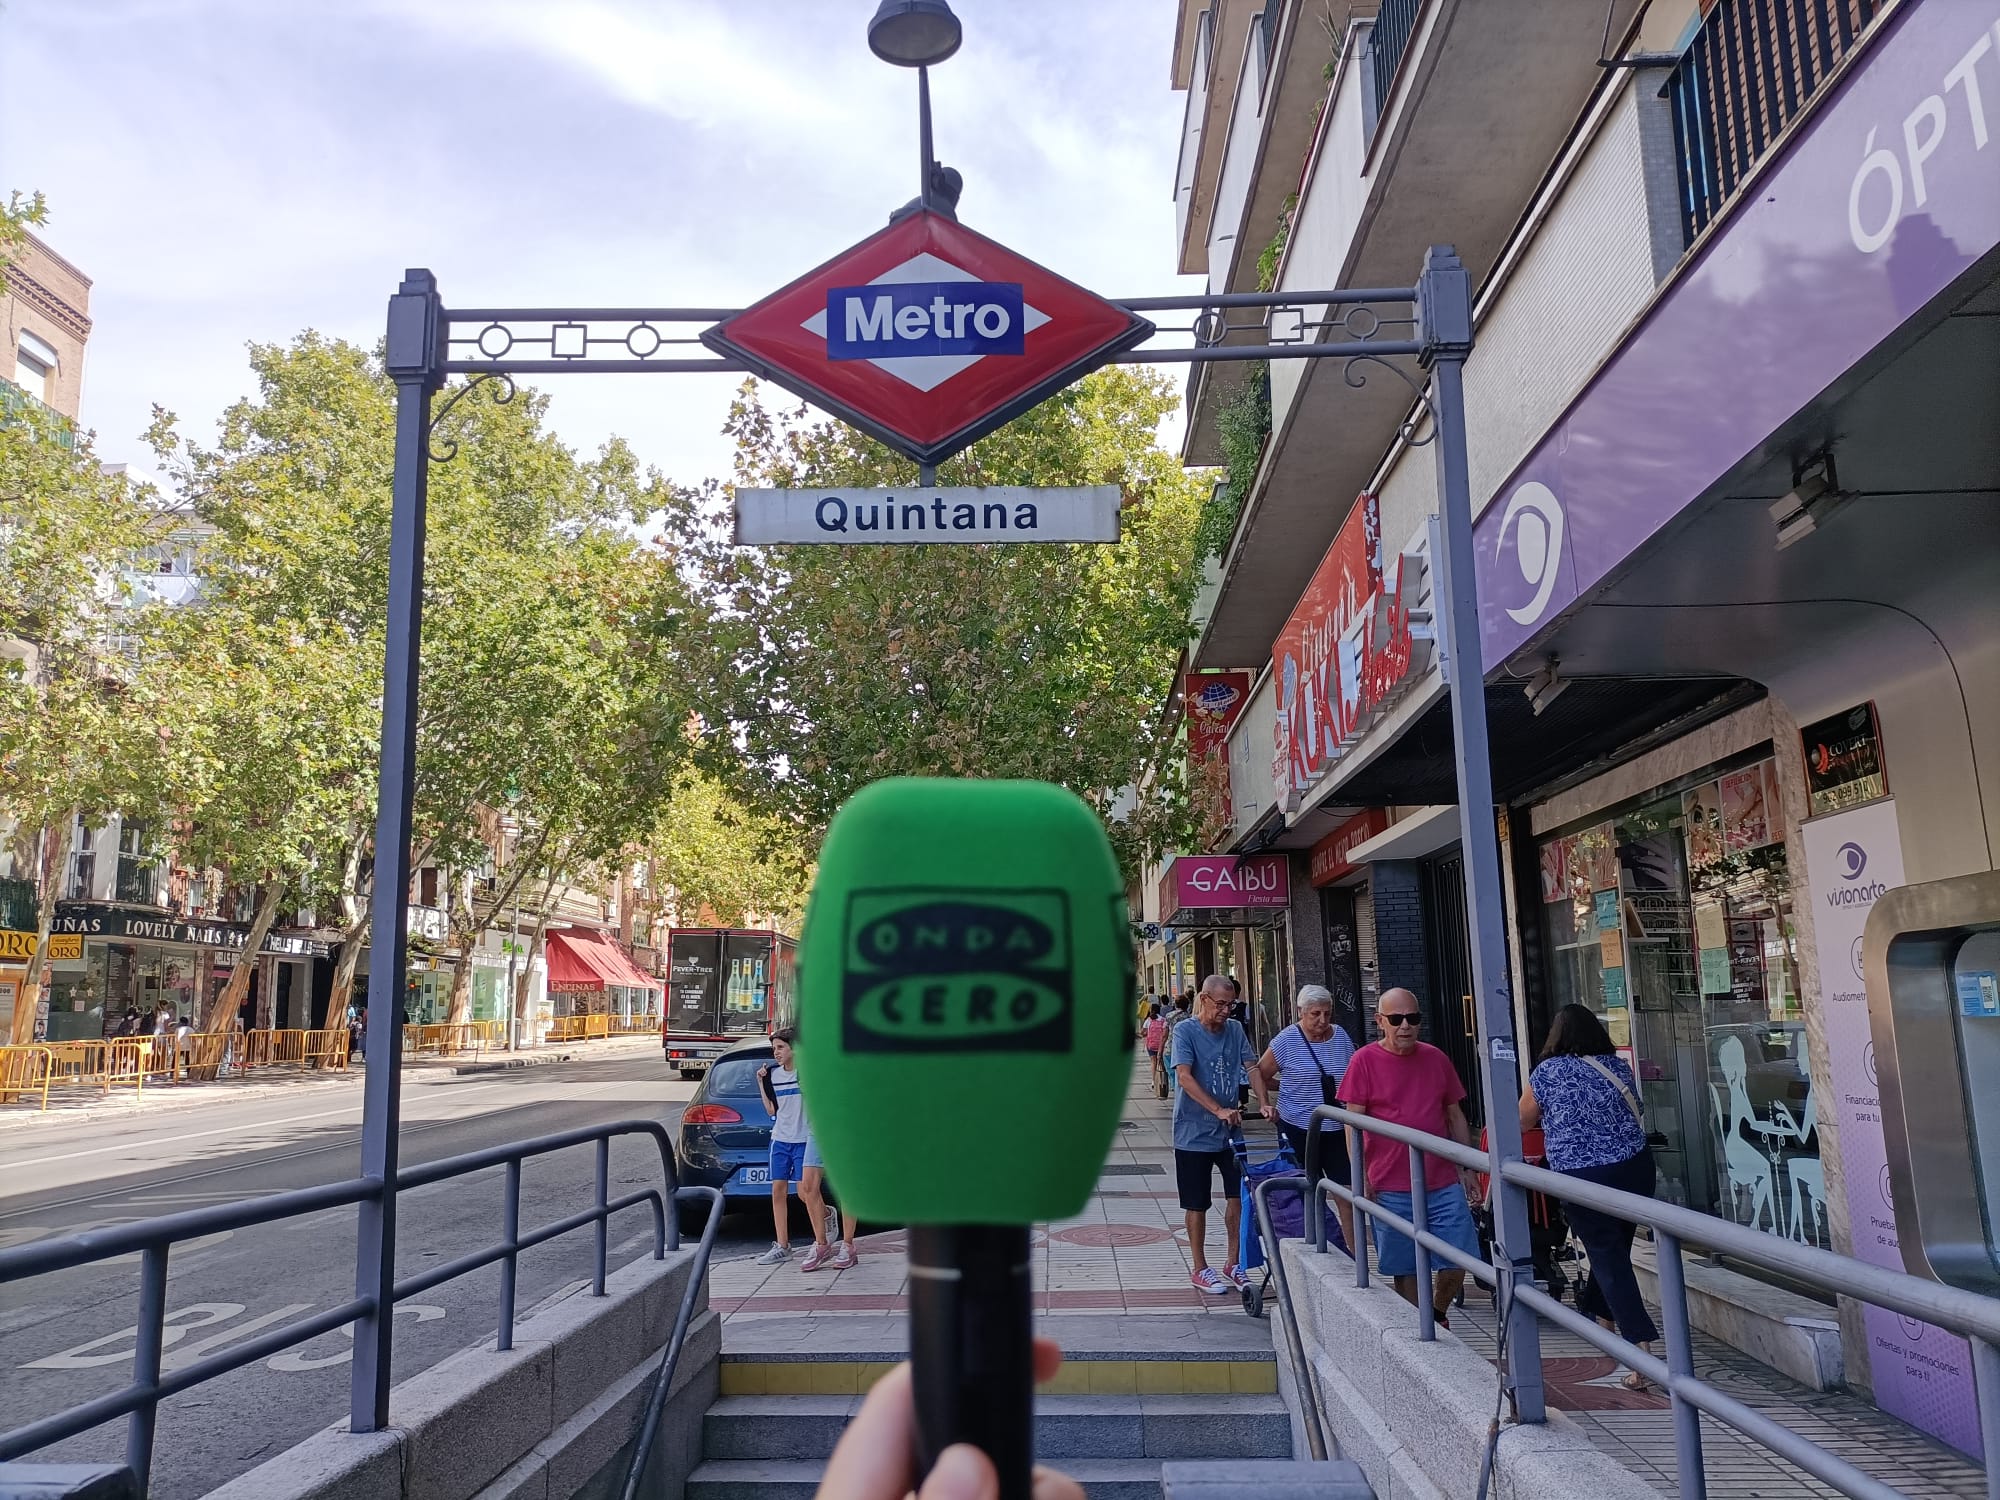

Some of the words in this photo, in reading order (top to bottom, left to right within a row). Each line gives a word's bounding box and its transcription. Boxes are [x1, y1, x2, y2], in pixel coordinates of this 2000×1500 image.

[845, 296, 1010, 342] Metro
[815, 497, 1038, 532] Quintana
[1827, 880, 1886, 907] visionarte
[50, 917, 101, 932] UÑAS
[126, 920, 178, 939] LOVELY
[187, 926, 221, 944] NAILS
[0, 932, 38, 956] RO
[873, 923, 1035, 953] ONDA
[49, 946, 80, 958] ORO
[551, 980, 596, 992] ENCINAS
[879, 984, 1038, 1025] CERO
[1856, 1112, 1871, 1123] para
[1871, 1216, 1895, 1231] Prueba
[1877, 1234, 1886, 1244] de
[1876, 1336, 1901, 1355] Ofertas
[1910, 1351, 1959, 1376] promociones
[1906, 1366, 1922, 1380] para
